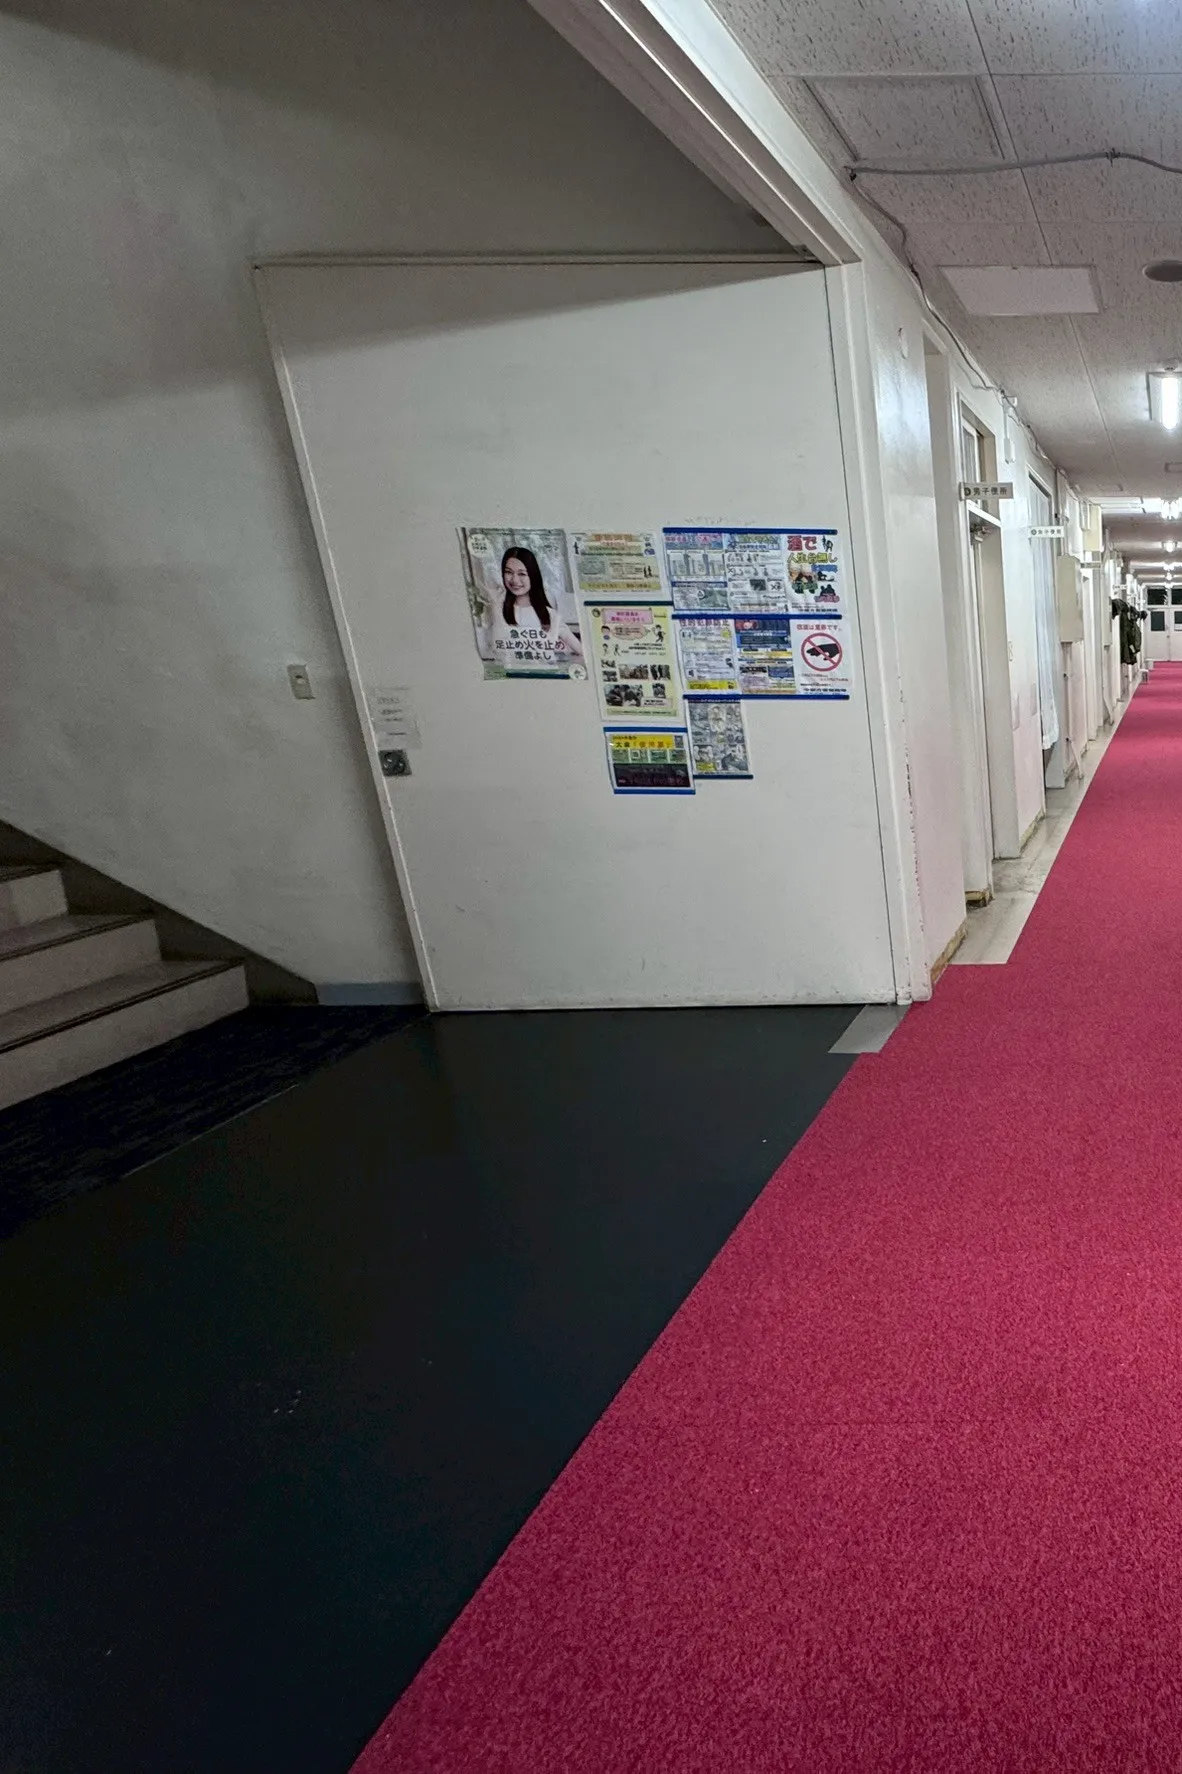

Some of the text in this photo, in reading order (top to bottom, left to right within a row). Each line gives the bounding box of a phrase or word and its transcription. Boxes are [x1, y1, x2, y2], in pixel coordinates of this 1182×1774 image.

[973, 487, 1007, 496] 男子便所
[787, 535, 817, 551] 酒で
[510, 629, 548, 639] 急ぐ日も
[495, 640, 566, 651] 足止め火を止め
[515, 651, 552, 661] 準備よし
